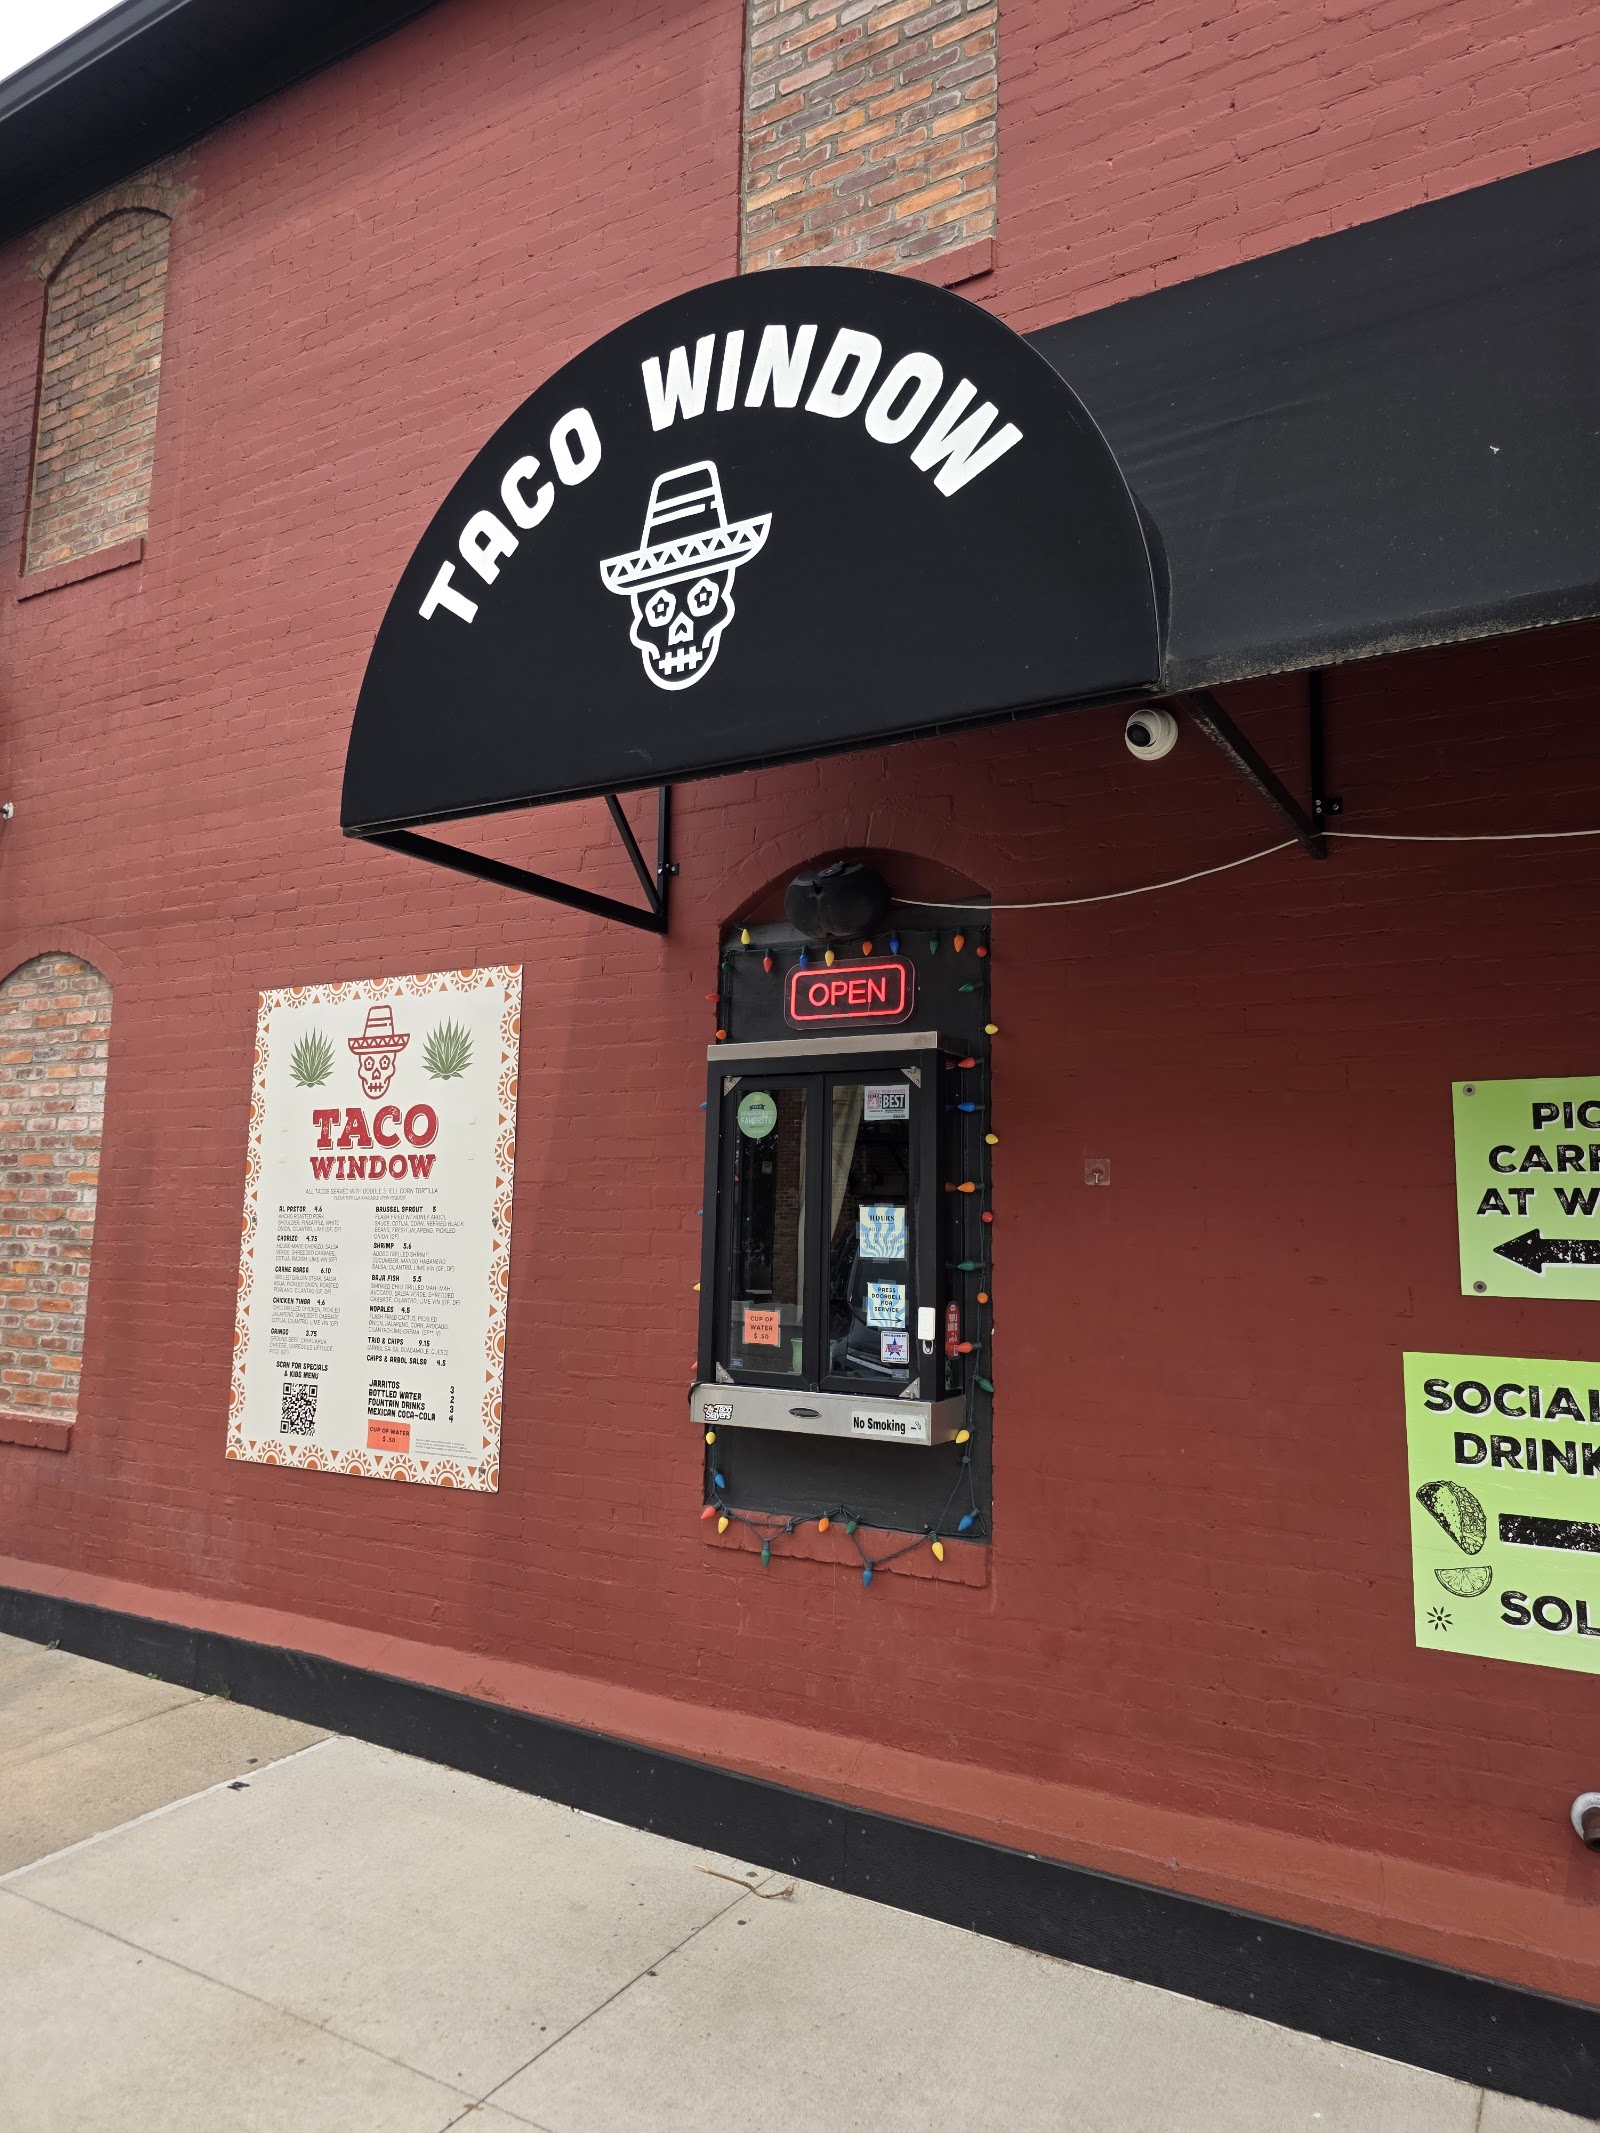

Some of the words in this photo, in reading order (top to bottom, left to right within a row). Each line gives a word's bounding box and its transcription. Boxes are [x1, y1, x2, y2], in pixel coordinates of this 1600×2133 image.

[418, 407, 602, 624] TACO
[641, 324, 1024, 498] WINDOW
[808, 977, 886, 1006] OPEN
[882, 1095, 904, 1108] BEST
[741, 1116, 773, 1125] FAVORITE
[1532, 1100, 1600, 1130] PIC
[312, 1104, 439, 1150] TACO
[310, 1154, 436, 1180] WINDOW
[1476, 1188, 1535, 1216] AT
[303, 1363, 328, 1371] SPECIALS
[369, 1379, 400, 1389] JARRITOS
[450, 1386, 454, 1394] 3
[369, 1389, 397, 1398] BOTTLED
[400, 1391, 421, 1400] WATER
[368, 1398, 399, 1408] FOUNTAIN
[402, 1401, 425, 1410] DRINKS
[715, 1405, 732, 1413] Taco
[368, 1407, 396, 1417] MEXICAN
[398, 1410, 435, 1421] COCA-COLA
[705, 1411, 731, 1420] Slayers
[854, 1417, 865, 1428] No
[868, 1418, 905, 1434] Smoking
[1454, 1432, 1600, 1476] DRINK
[1501, 1591, 1600, 1636] SOL
